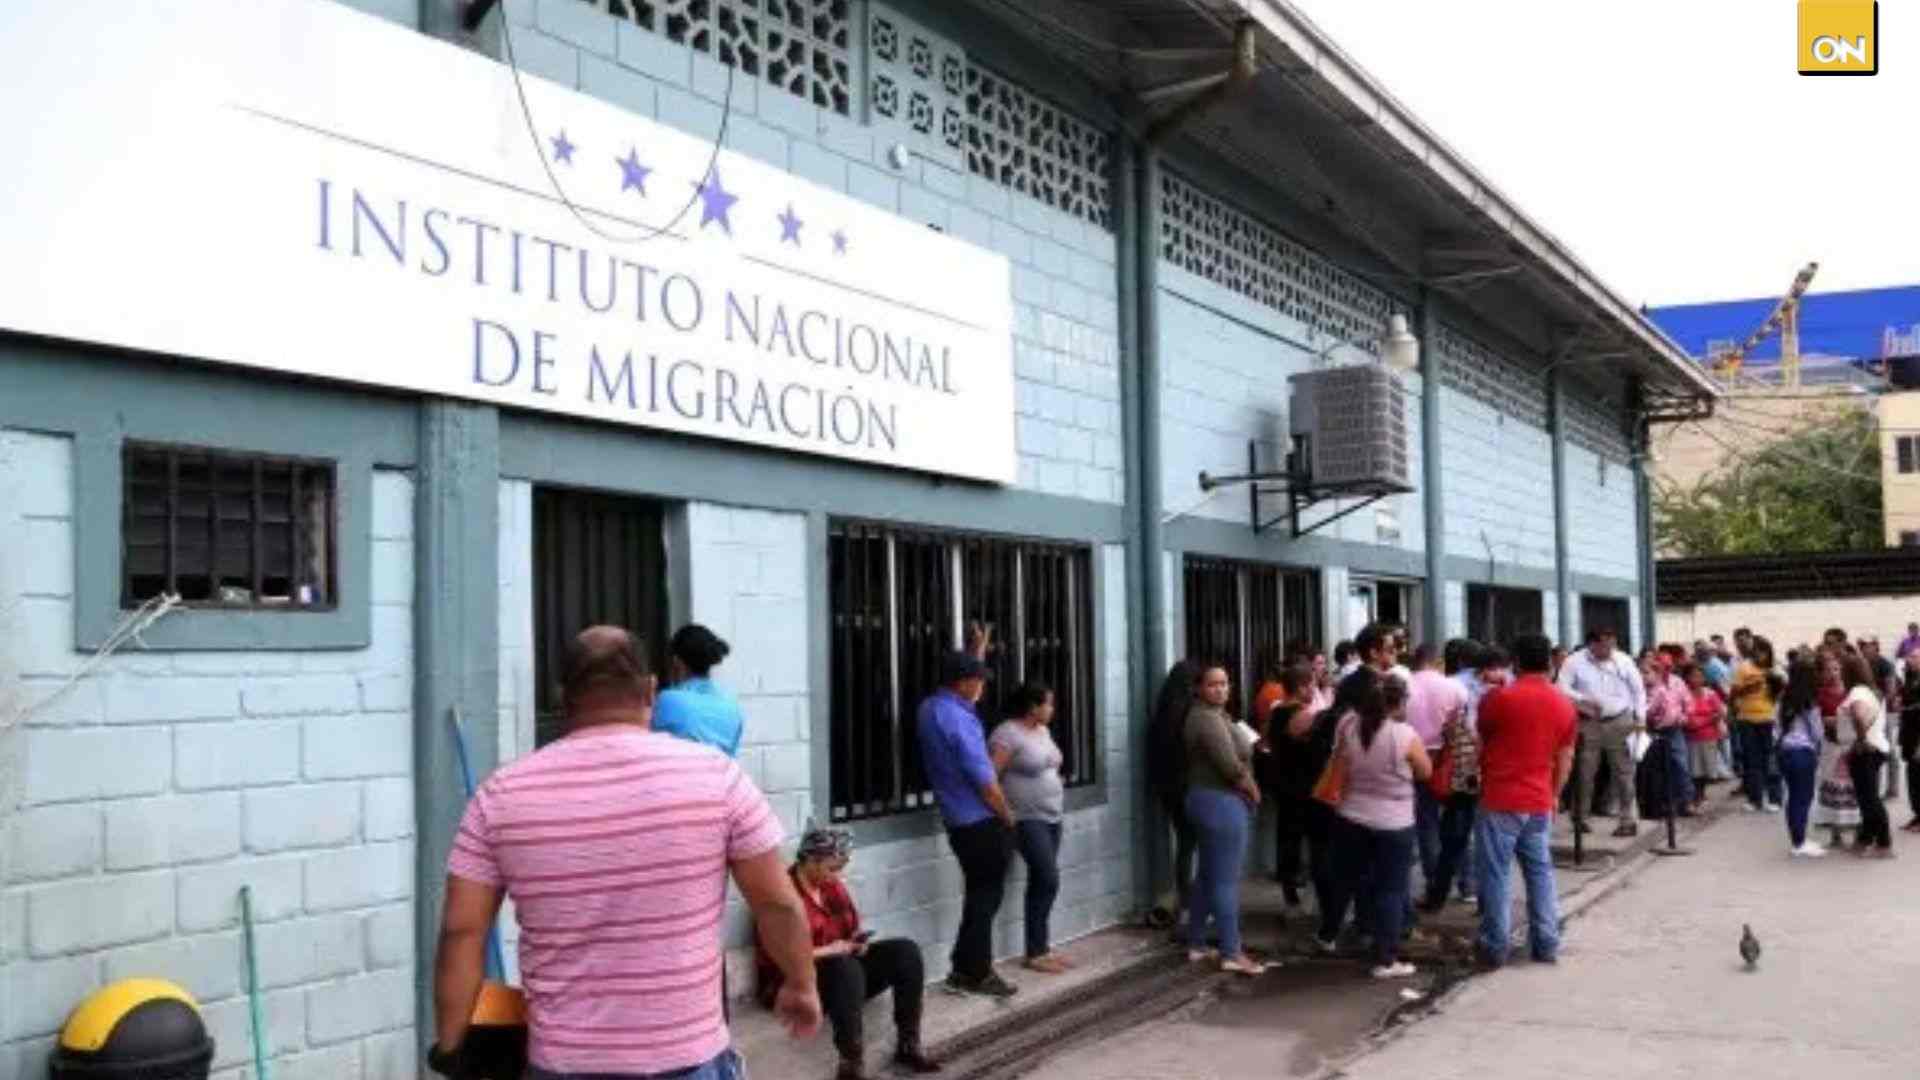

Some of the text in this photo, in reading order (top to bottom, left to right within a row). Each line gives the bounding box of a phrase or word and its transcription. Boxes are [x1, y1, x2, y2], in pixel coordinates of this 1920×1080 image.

[317, 180, 958, 395] INSTITUTO NACIONAL
[472, 319, 897, 451] DE MIGRACIÓN
